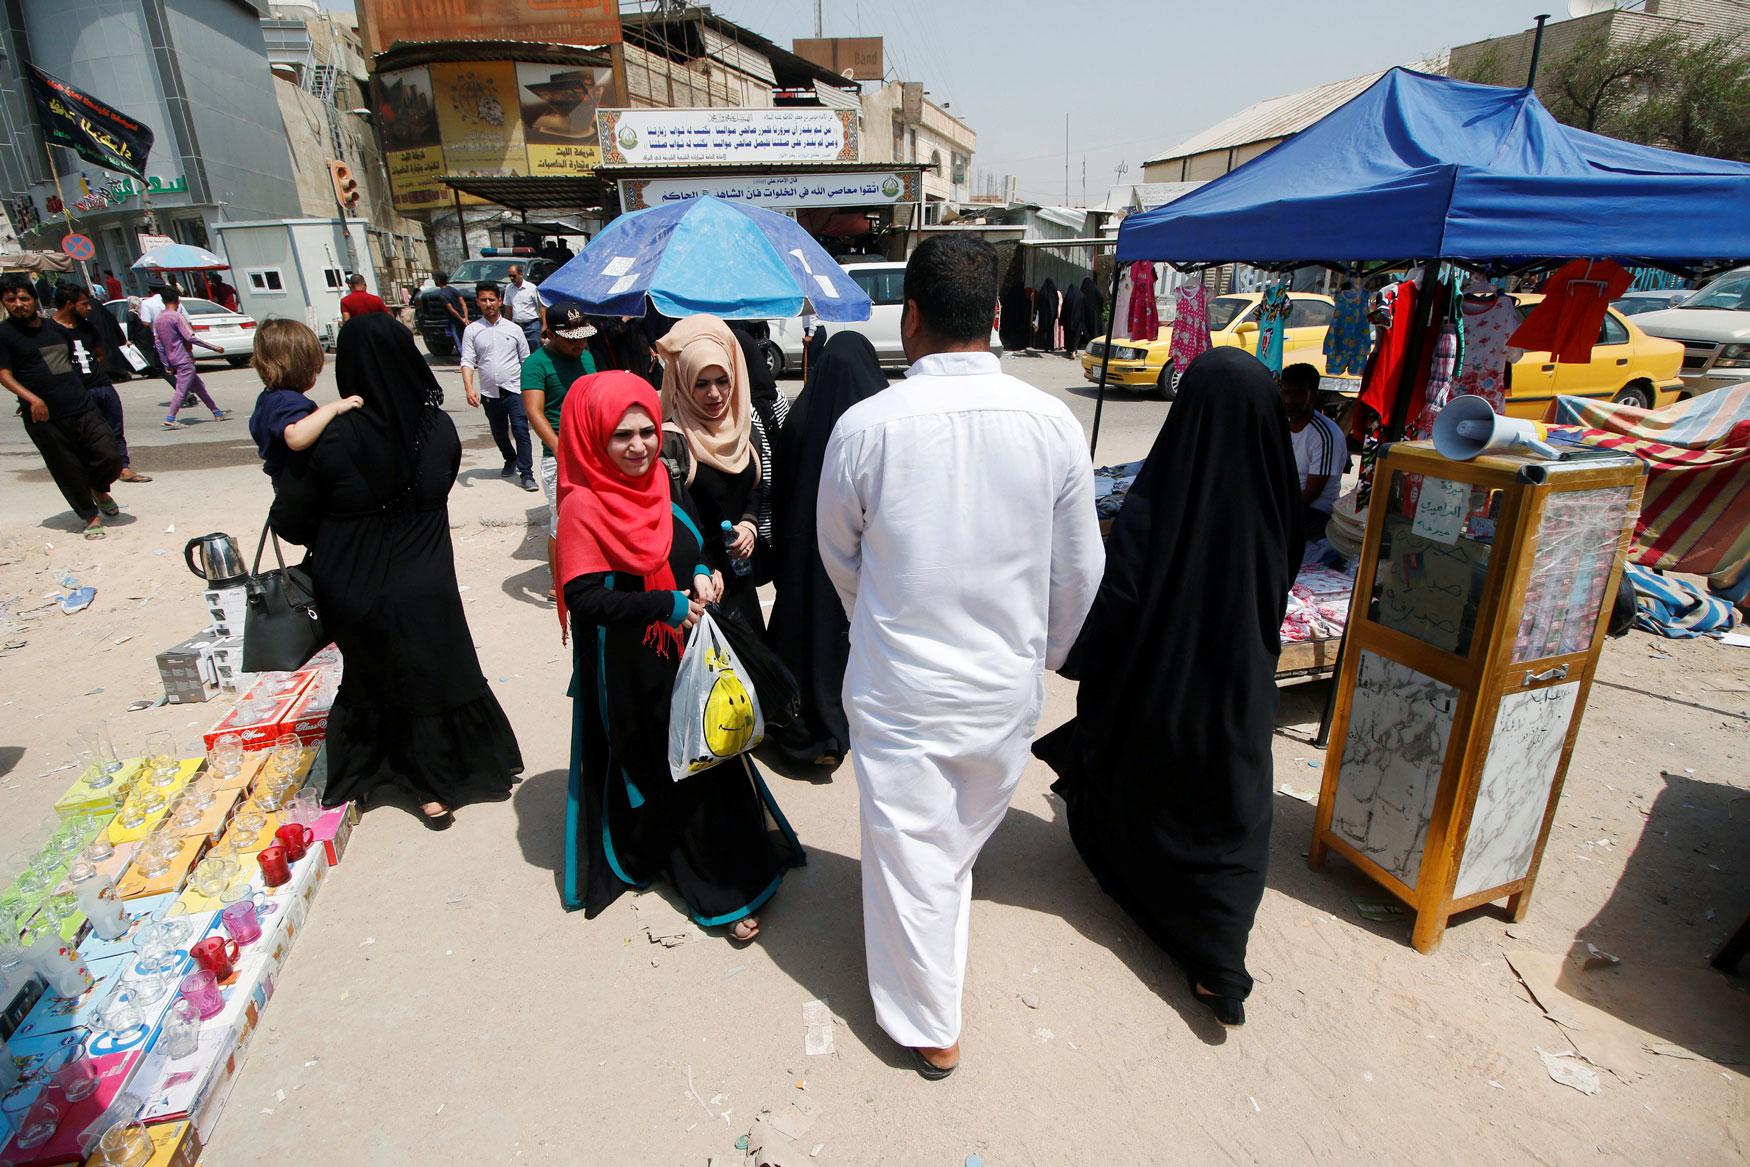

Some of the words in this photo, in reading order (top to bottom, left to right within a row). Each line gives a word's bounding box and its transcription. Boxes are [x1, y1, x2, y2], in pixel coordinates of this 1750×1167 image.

[763, 186, 797, 199] الخلوات
[798, 186, 809, 199] في
[811, 186, 826, 196] الله
[827, 186, 857, 198] معاصي
